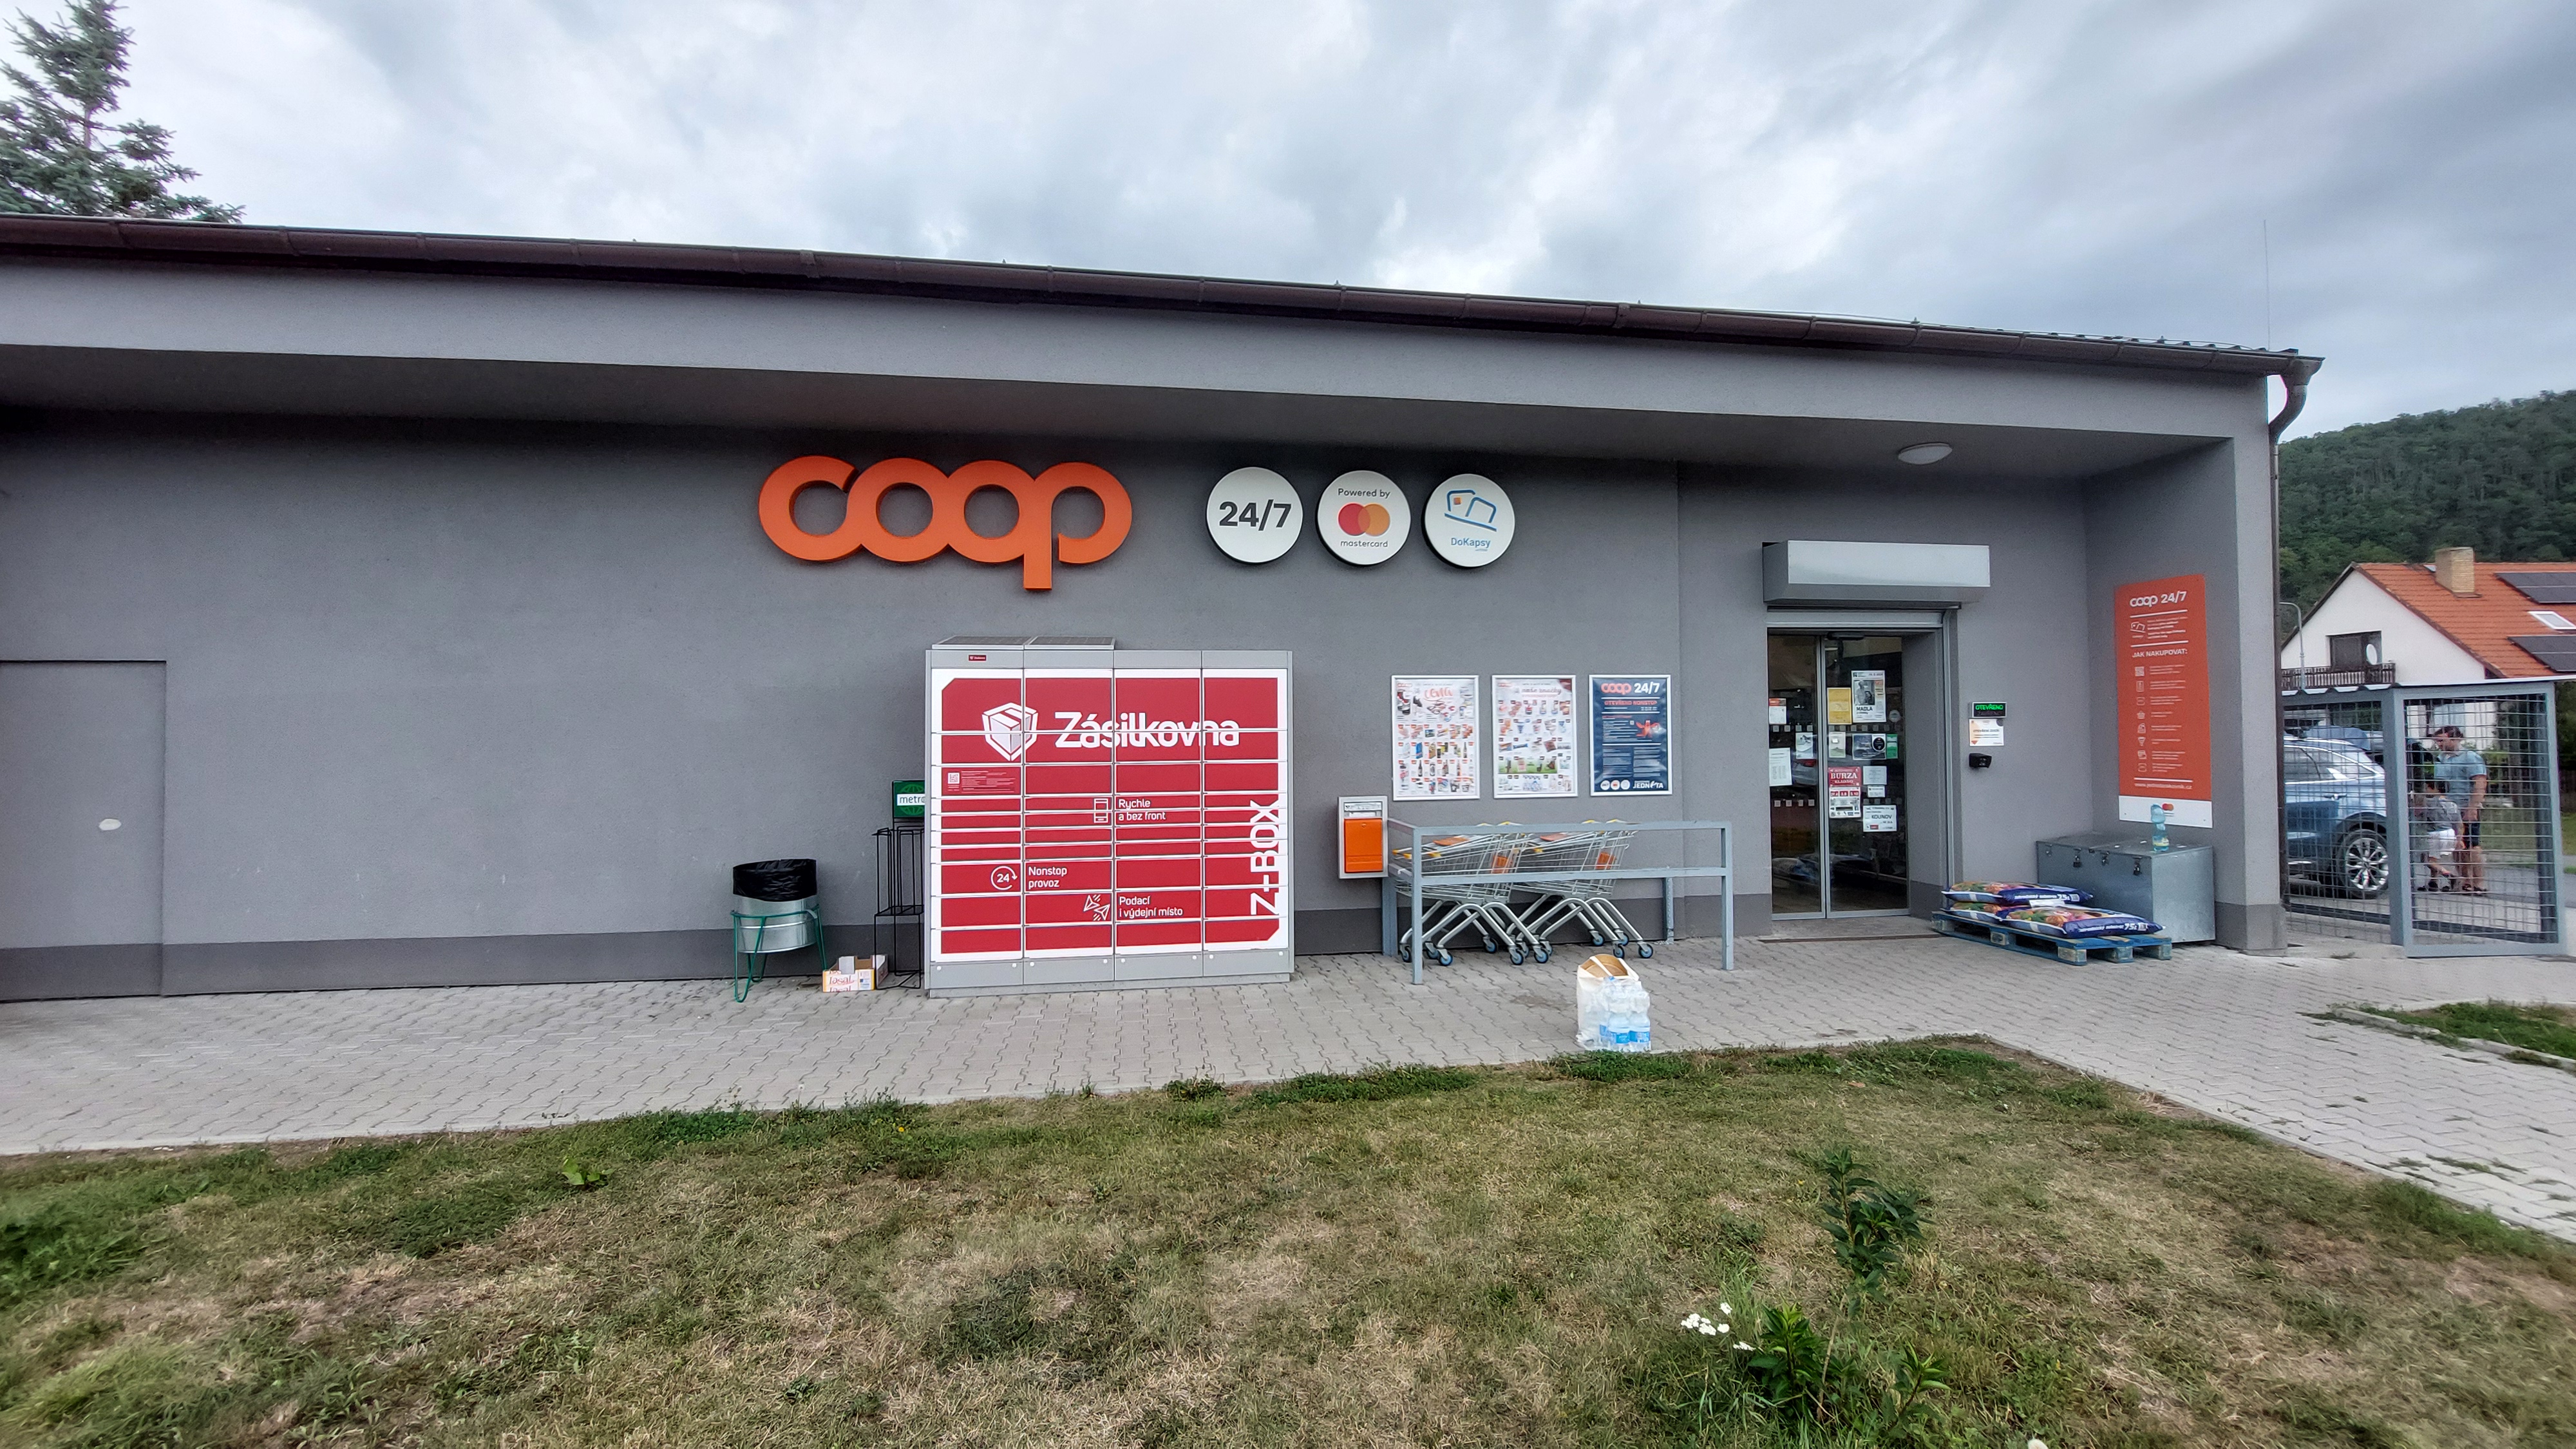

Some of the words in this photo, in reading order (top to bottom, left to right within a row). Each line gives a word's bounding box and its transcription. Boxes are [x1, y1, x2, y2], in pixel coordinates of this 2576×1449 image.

[1338, 488, 1377, 498] Powered
[1379, 489, 1390, 499] by
[1218, 499, 1292, 531] 24/7
[758, 455, 1132, 591] coop
[1340, 540, 1388, 548] mastercard
[1451, 537, 1491, 548] DoKapsy
[2161, 591, 2187, 603] 24/7
[2146, 648, 2188, 658] NAKUPOVAT:
[1634, 681, 1660, 694] 24/7
[1054, 712, 1240, 748] Zásilkovna
[1119, 798, 1150, 810] Rychle
[1126, 811, 1142, 821] bez
[1145, 811, 1166, 822] front
[1251, 800, 1280, 915] Z-BOX
[1028, 866, 1067, 877] Nonstop
[997, 873, 1010, 883] 24
[1028, 879, 1059, 889] provoz
[1119, 896, 1150, 905] Podací
[1123, 907, 1157, 918] výdejní
[1158, 907, 1183, 916] místo
